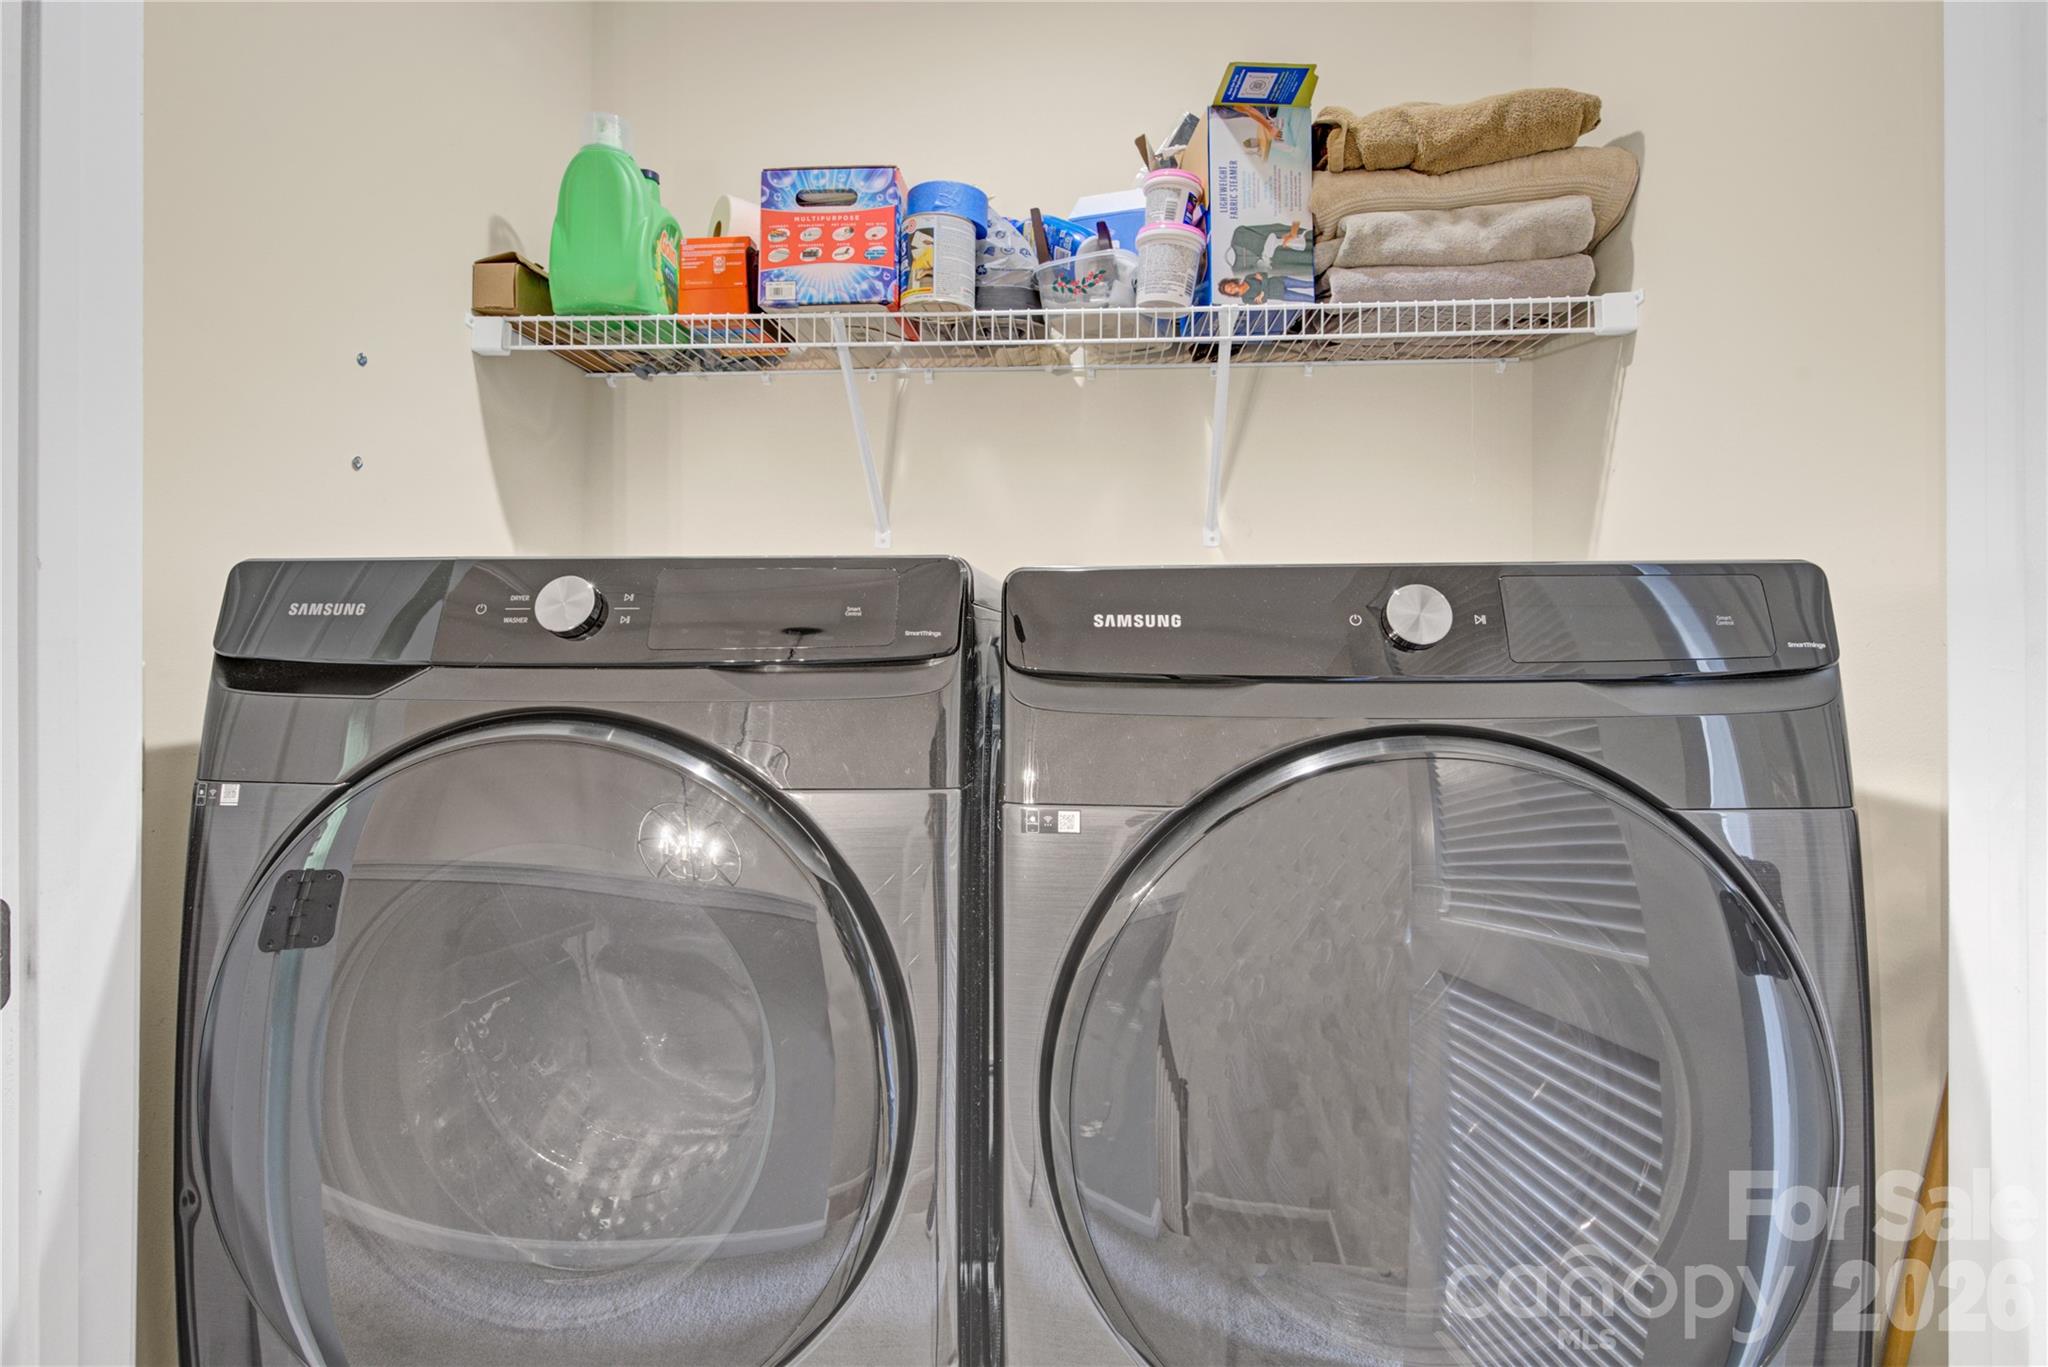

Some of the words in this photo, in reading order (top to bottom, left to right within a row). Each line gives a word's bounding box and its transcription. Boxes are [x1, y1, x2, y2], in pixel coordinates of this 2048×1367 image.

[1229, 160, 1239, 192] STEAMER
[1218, 166, 1228, 213] LIGHTWEIGHT
[1229, 194, 1239, 220] FABRIC
[793, 214, 861, 223] MULTIPURPOSE
[288, 602, 367, 616] SAMSUNG
[503, 616, 529, 624] WASHER
[1093, 613, 1182, 628] SAMSUNG
[904, 630, 942, 638] SmartThings
[1787, 641, 1826, 649] SmartThings
